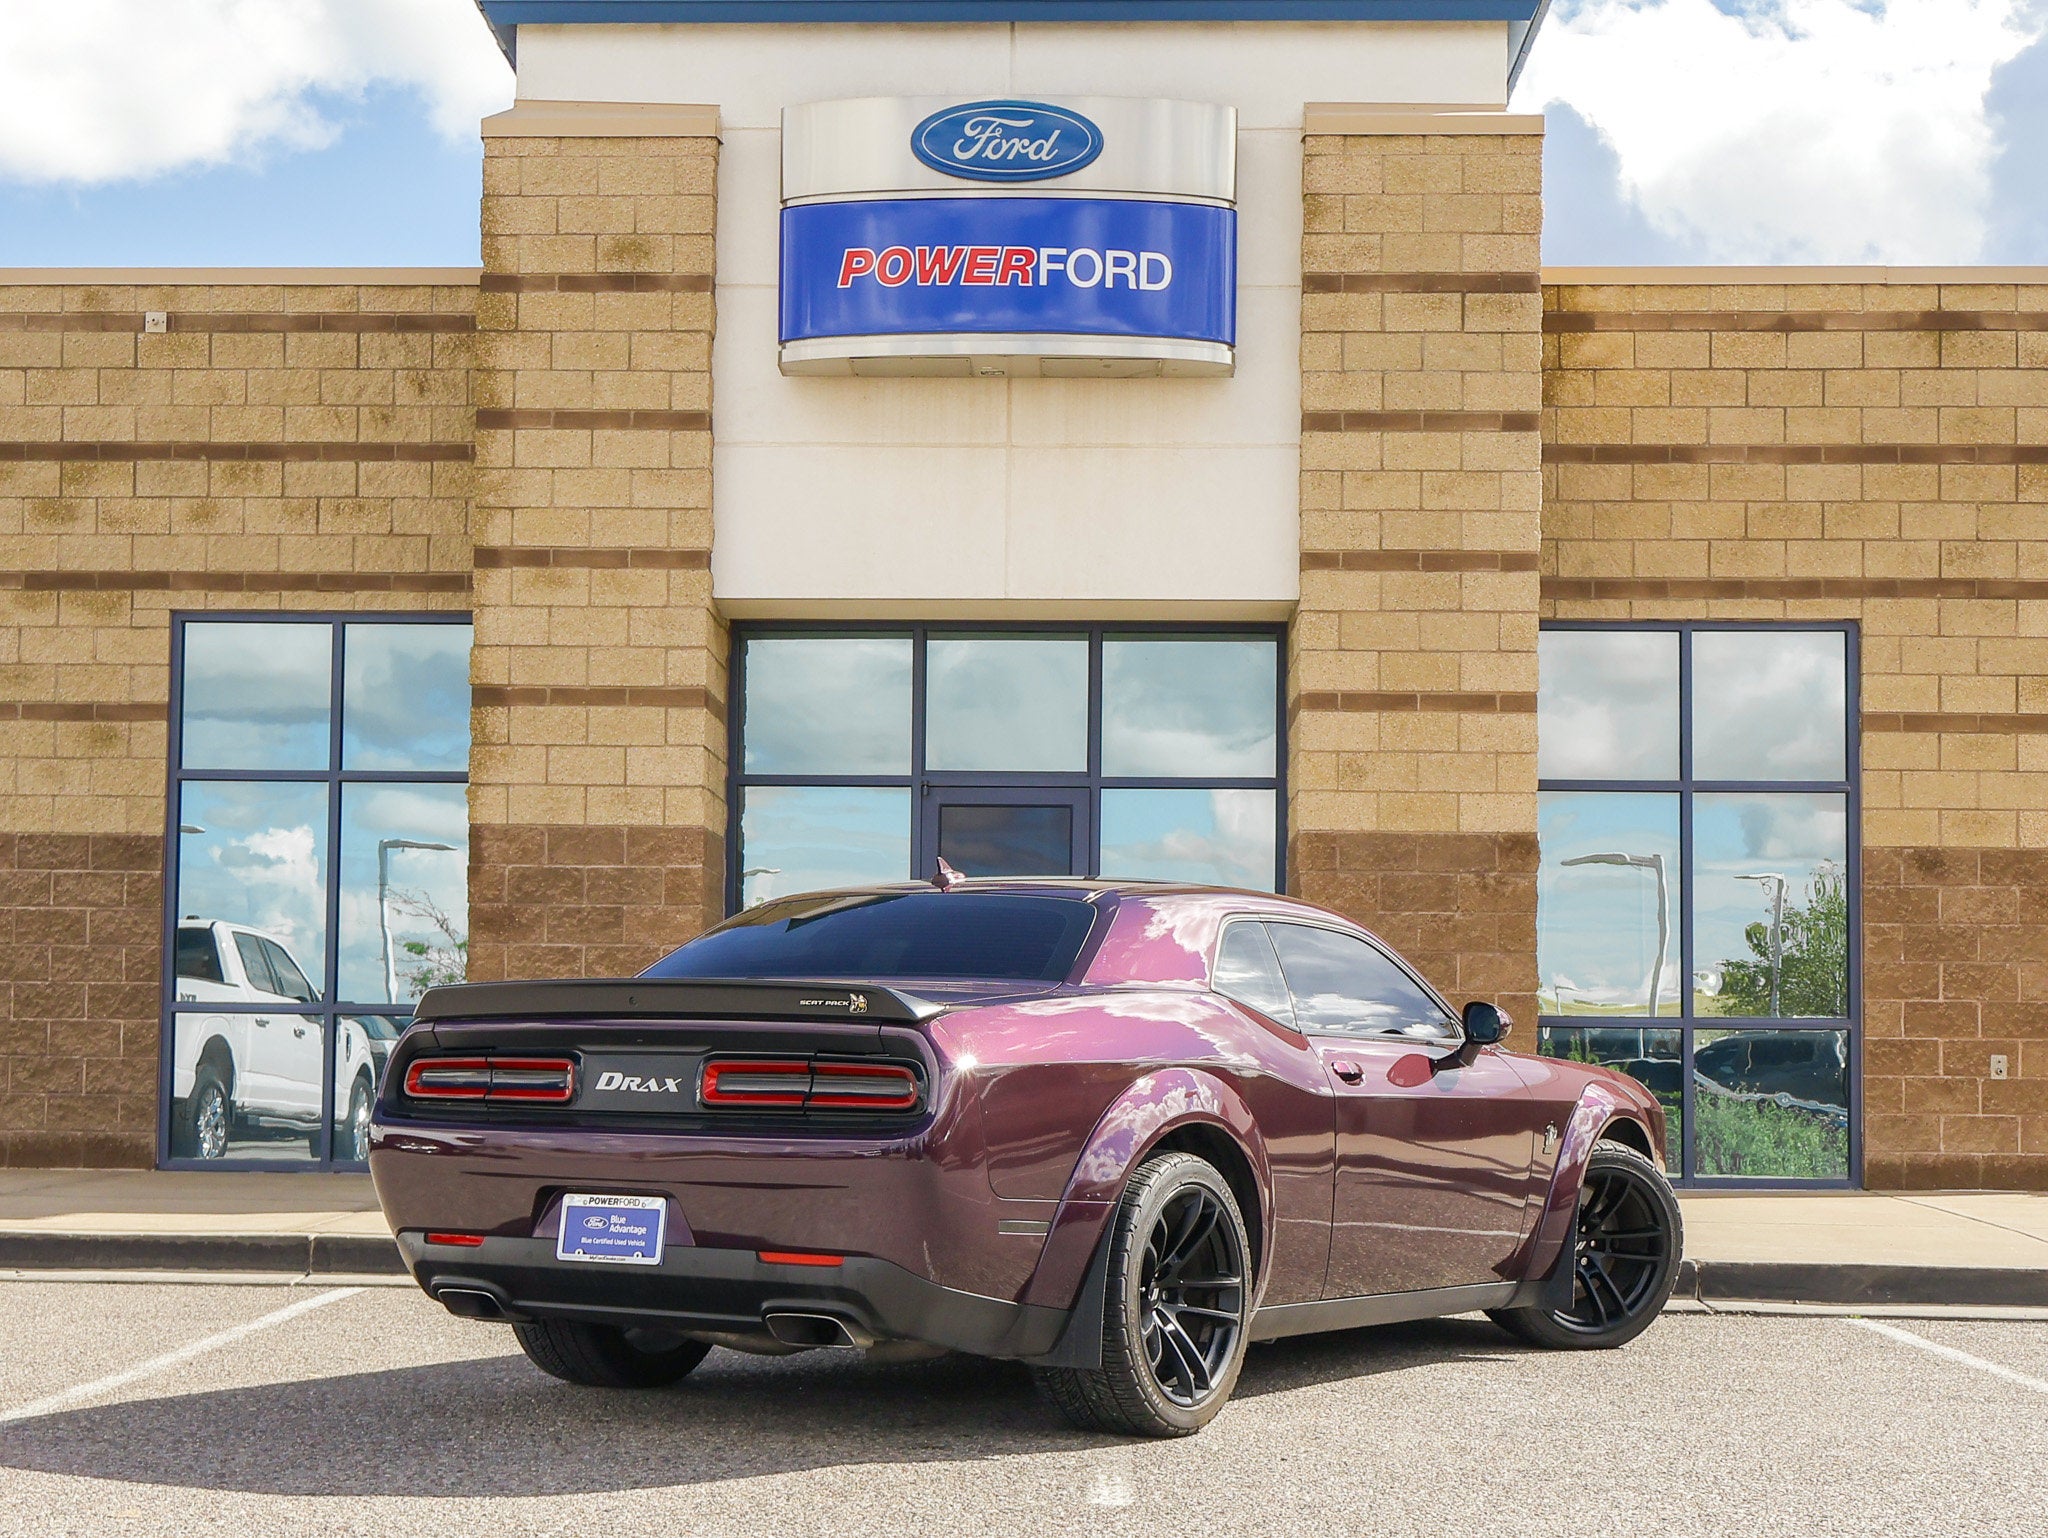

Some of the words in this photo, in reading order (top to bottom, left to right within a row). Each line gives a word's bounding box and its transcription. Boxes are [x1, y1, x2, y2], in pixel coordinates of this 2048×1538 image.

[953, 116, 1061, 162] Ford
[837, 245, 1173, 291] POWERFORD
[589, 1197, 640, 1206] POWERFORD
[588, 1217, 604, 1227] Ford
[610, 1215, 626, 1224] Blue
[609, 1224, 647, 1235] Advantage
[593, 1237, 613, 1245] Certified
